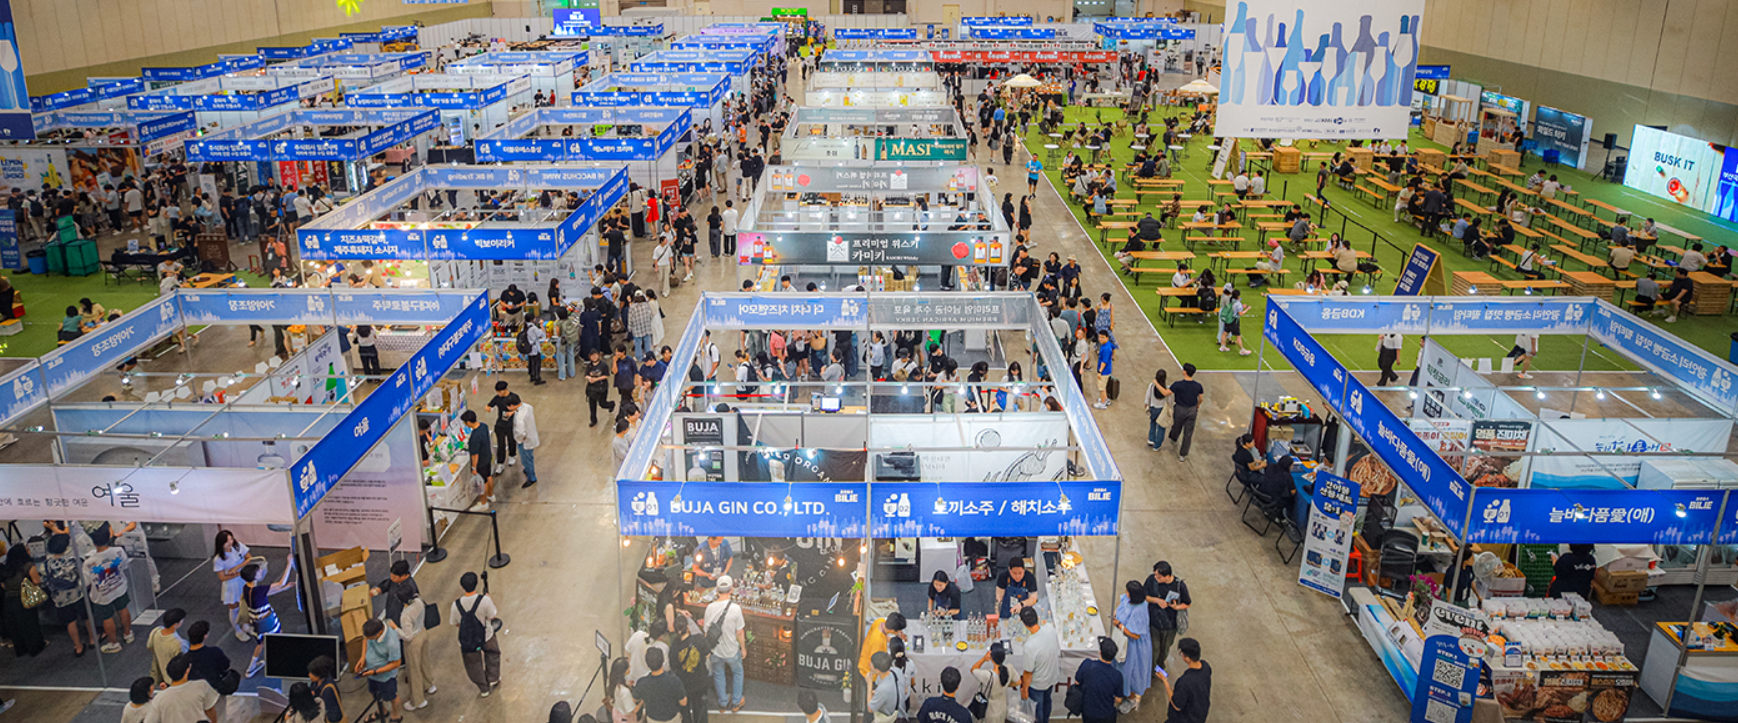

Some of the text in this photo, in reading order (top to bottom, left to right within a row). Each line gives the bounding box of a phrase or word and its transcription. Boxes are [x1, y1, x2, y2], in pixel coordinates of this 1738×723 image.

[890, 143, 931, 156] MASI
[1654, 151, 1696, 171] BUSK IT
[474, 238, 515, 248] 빅보이리커
[852, 238, 919, 250] 프리미엄 위스키
[334, 245, 399, 255] 제주흑돼지 소시지
[852, 250, 886, 261] 카미키
[1293, 337, 1316, 366] KDB금융
[688, 422, 719, 432] BUJA
[92, 482, 140, 508] 여울
[834, 494, 858, 502] BILIE
[1088, 492, 1111, 501] BILIE
[17, 498, 41, 508] 흐르는
[46, 497, 70, 508] 향긋한
[670, 501, 714, 514] BUJA
[719, 501, 748, 514] GIN
[794, 501, 830, 515] LTD.
[932, 499, 1073, 516] 토끼소주 / 해치소주
[1689, 501, 1713, 510] BILIE
[1549, 506, 1655, 524] 늘바다품愛(애)
[1435, 606, 1484, 631] event
[798, 653, 830, 670] BUJA
